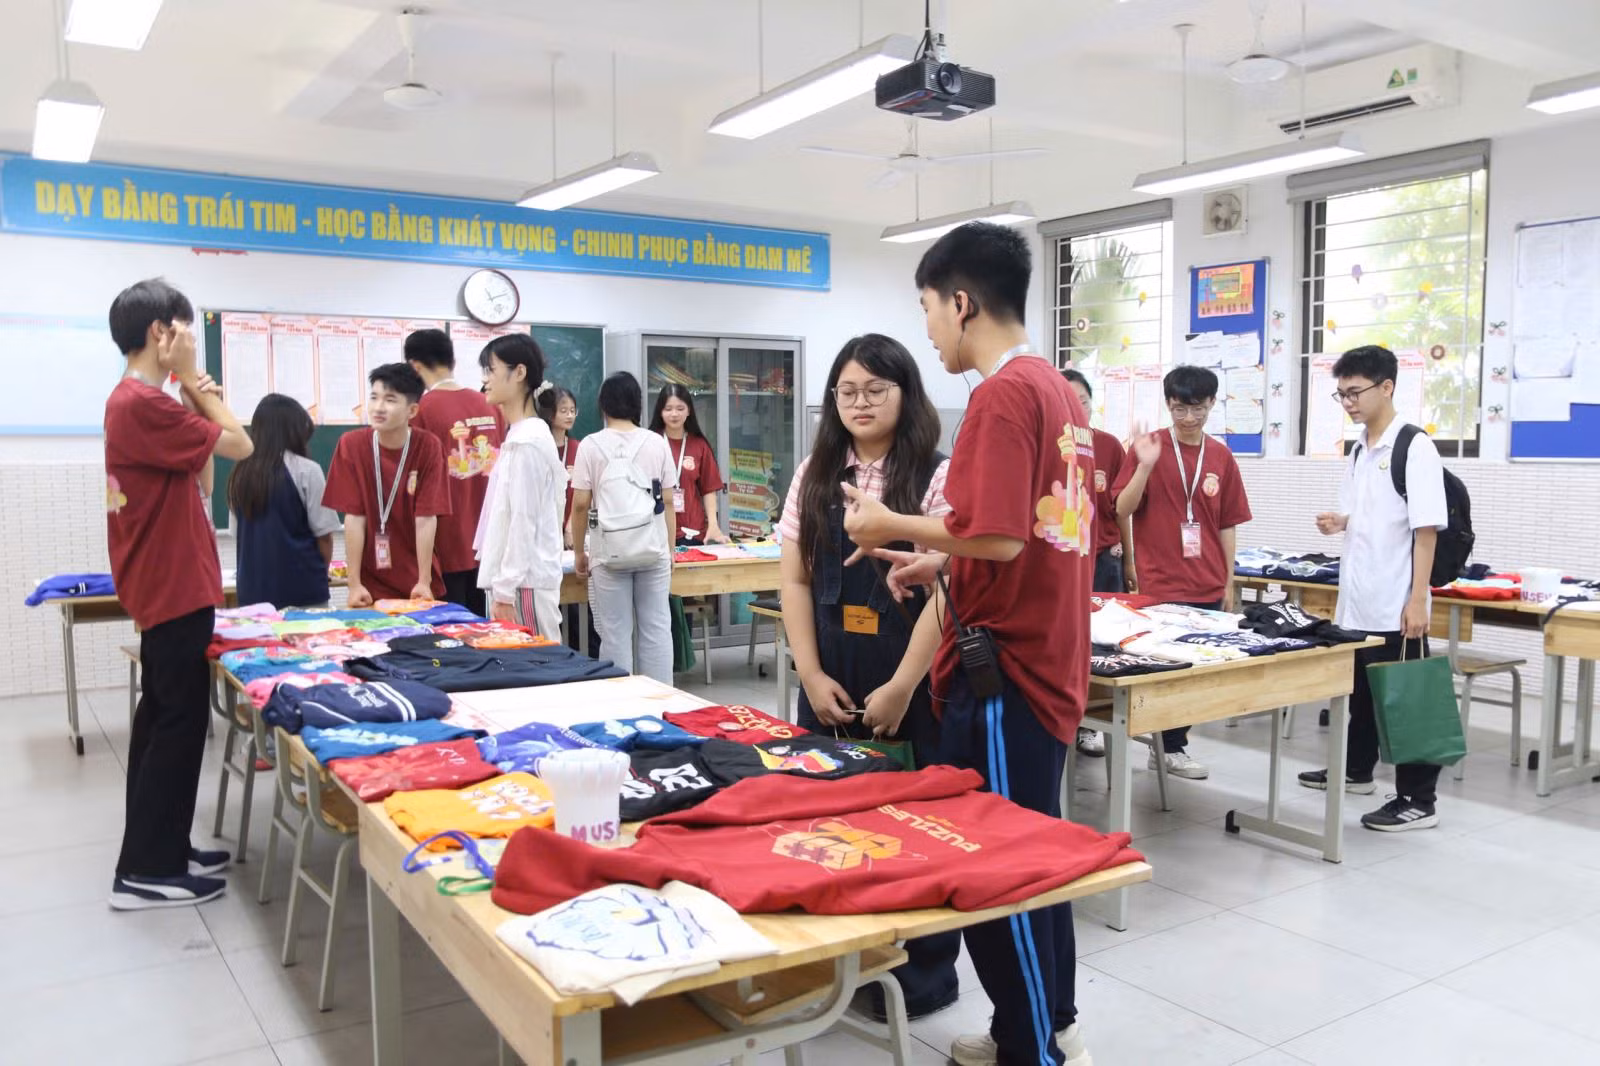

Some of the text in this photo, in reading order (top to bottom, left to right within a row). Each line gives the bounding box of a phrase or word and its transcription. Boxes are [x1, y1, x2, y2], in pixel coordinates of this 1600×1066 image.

[35, 180, 95, 222] DẠY
[102, 178, 179, 225] BẰNG
[183, 192, 244, 230] TRÁI
[249, 201, 298, 233] TIM
[317, 207, 366, 244] HỌC
[371, 203, 433, 243] BẰNG
[439, 214, 496, 247] KHÁT
[500, 222, 557, 256] VỌNG
[573, 229, 634, 259] CHINH
[638, 234, 689, 268] PHỤC
[692, 232, 740, 267] BẰNG
[786, 246, 812, 274] MÊ
[877, 804, 982, 852] PUZZLES
